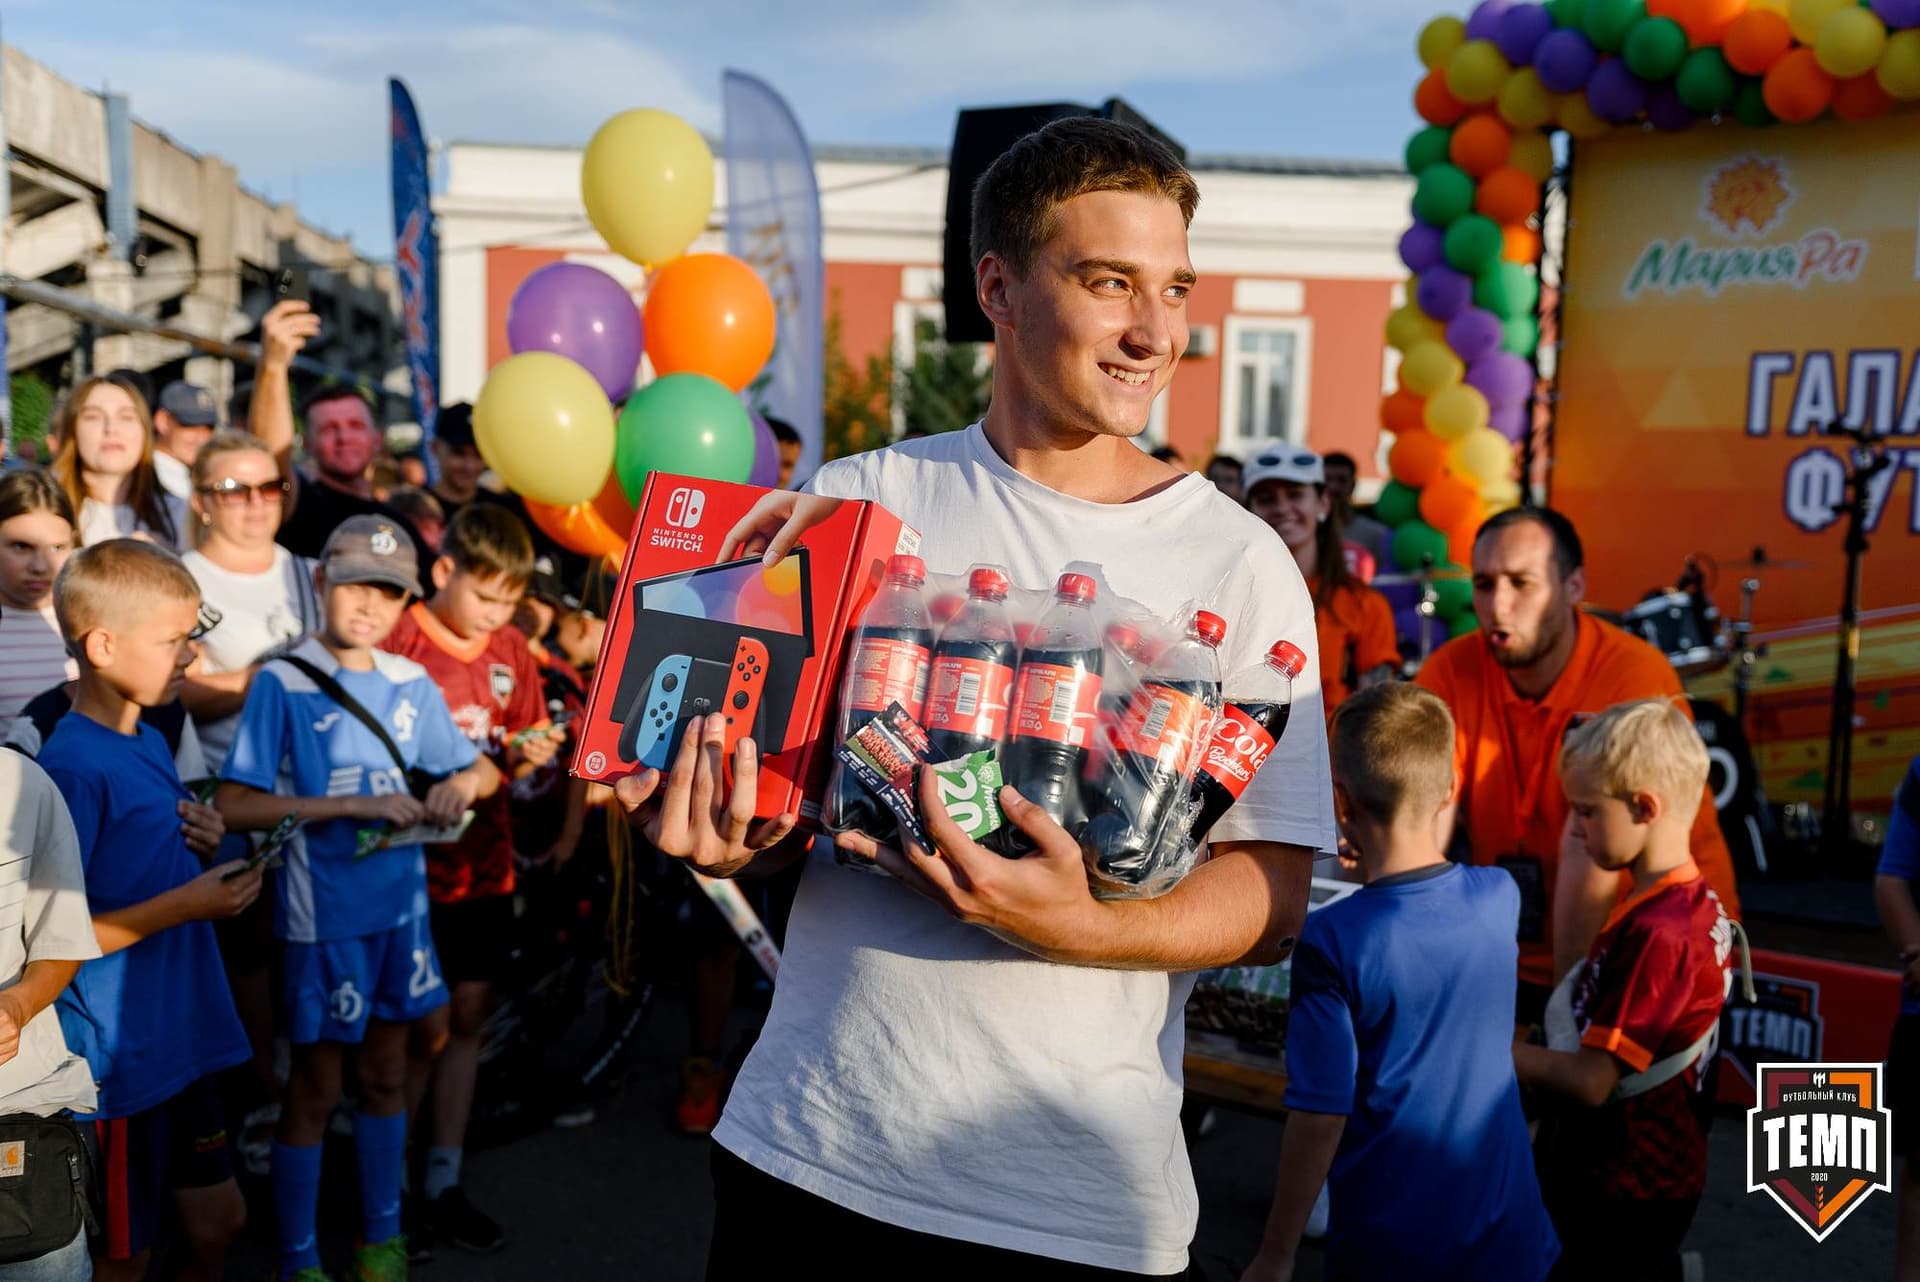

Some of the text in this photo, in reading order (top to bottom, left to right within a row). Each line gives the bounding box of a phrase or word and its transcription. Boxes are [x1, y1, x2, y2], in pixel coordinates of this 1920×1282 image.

[653, 528, 704, 541] NINTENDO
[937, 769, 983, 833] 20
[1729, 1007, 1812, 1059] ТЕМП
